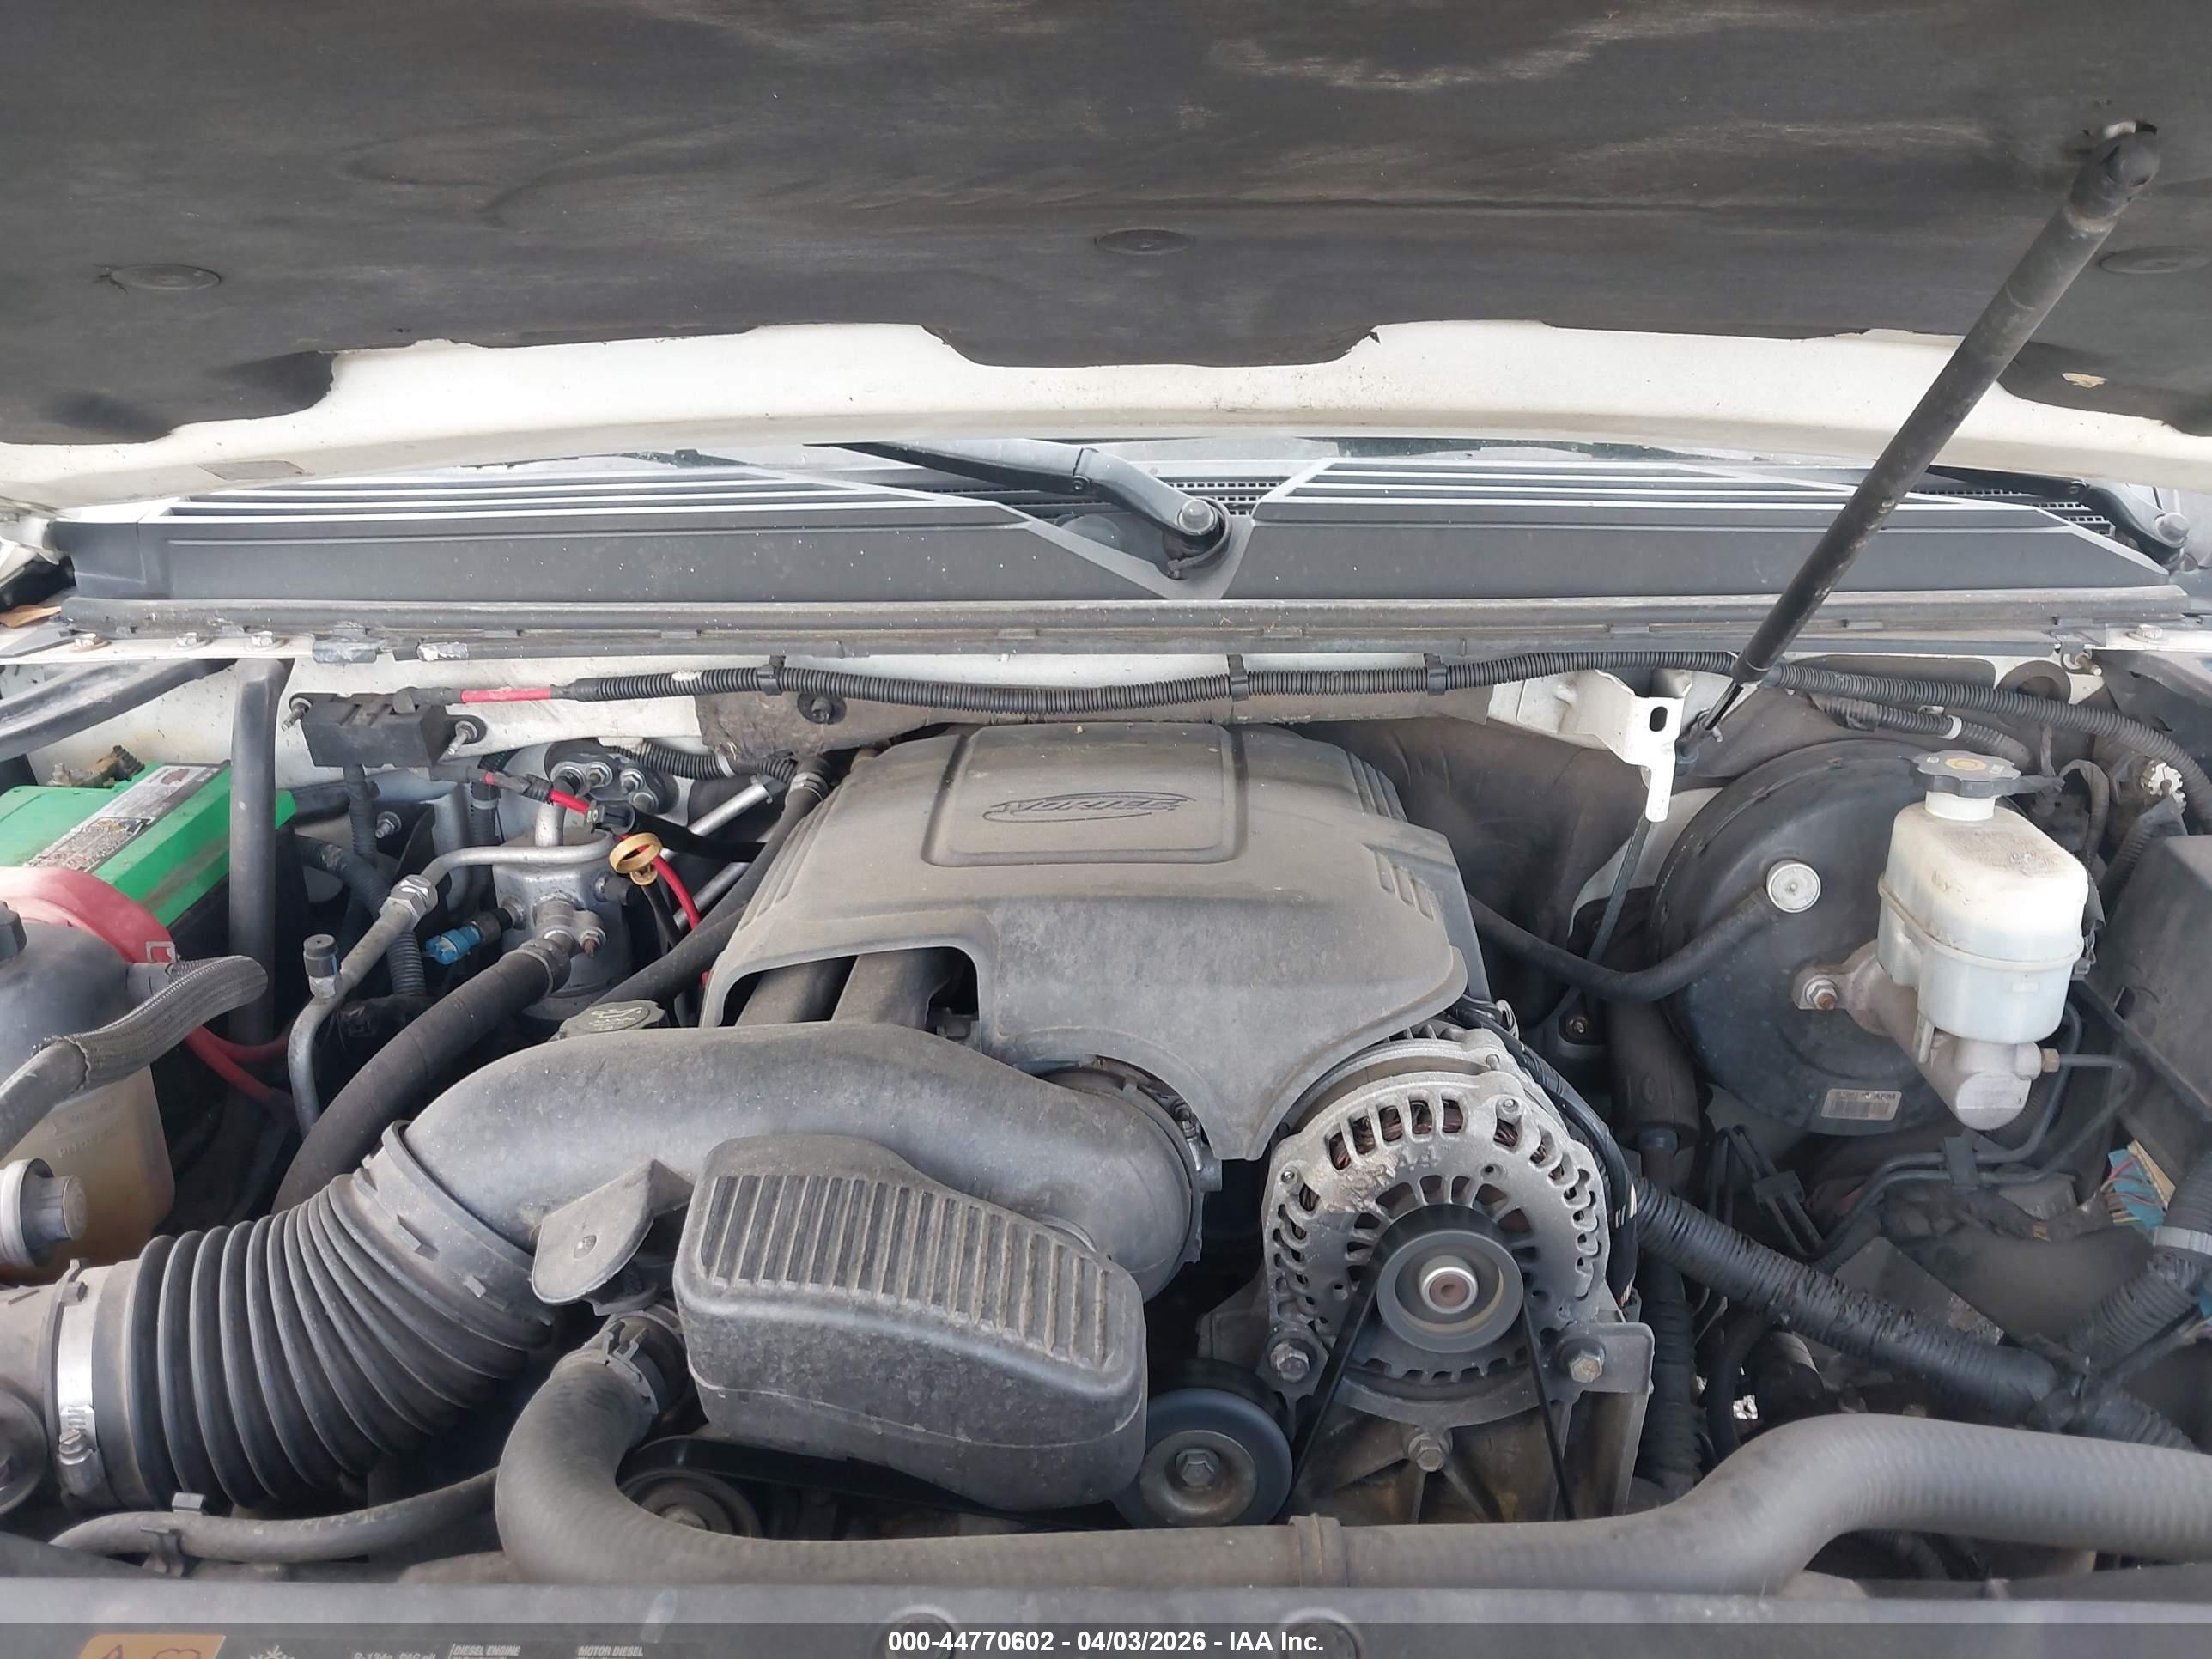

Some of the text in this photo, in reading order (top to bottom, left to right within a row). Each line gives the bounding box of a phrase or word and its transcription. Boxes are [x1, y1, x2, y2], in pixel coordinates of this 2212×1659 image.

[453, 1644, 521, 1656] DIESEL ENGINE
[577, 1645, 644, 1657] MOTOR DIESEL
